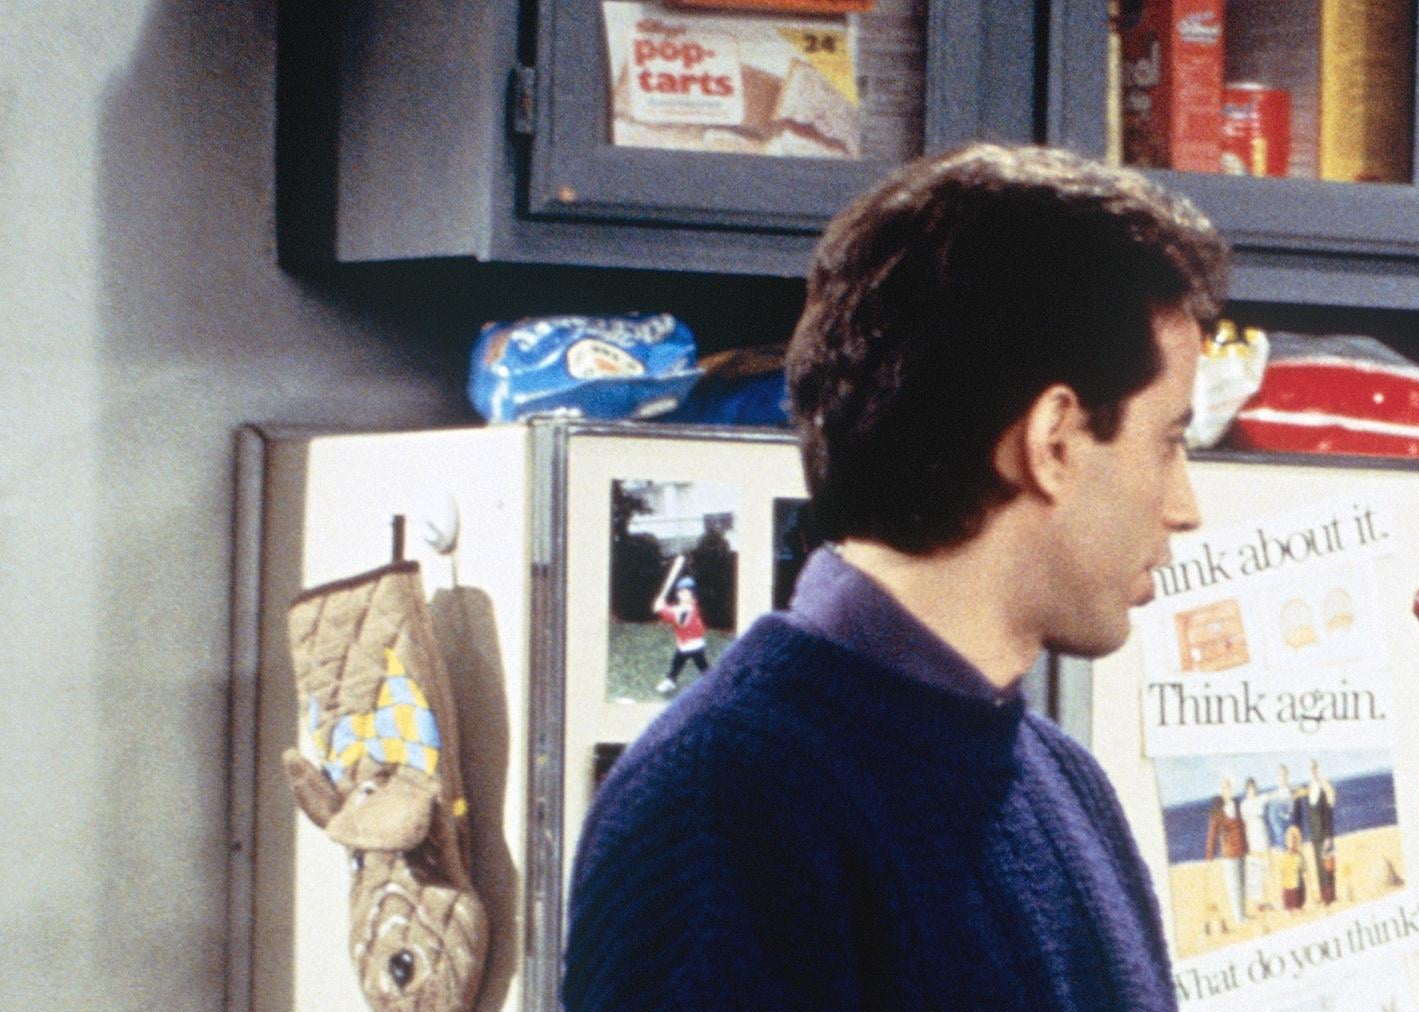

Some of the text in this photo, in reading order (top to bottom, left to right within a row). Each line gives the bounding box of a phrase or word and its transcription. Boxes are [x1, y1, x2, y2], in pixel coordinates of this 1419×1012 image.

[634, 38, 715, 69] pop-
[638, 70, 735, 97] tarts
[1152, 503, 1390, 597] ink about it.
[1148, 679, 1387, 735] Think again.
[1247, 949, 1286, 984] do
[1289, 936, 1343, 981] you
